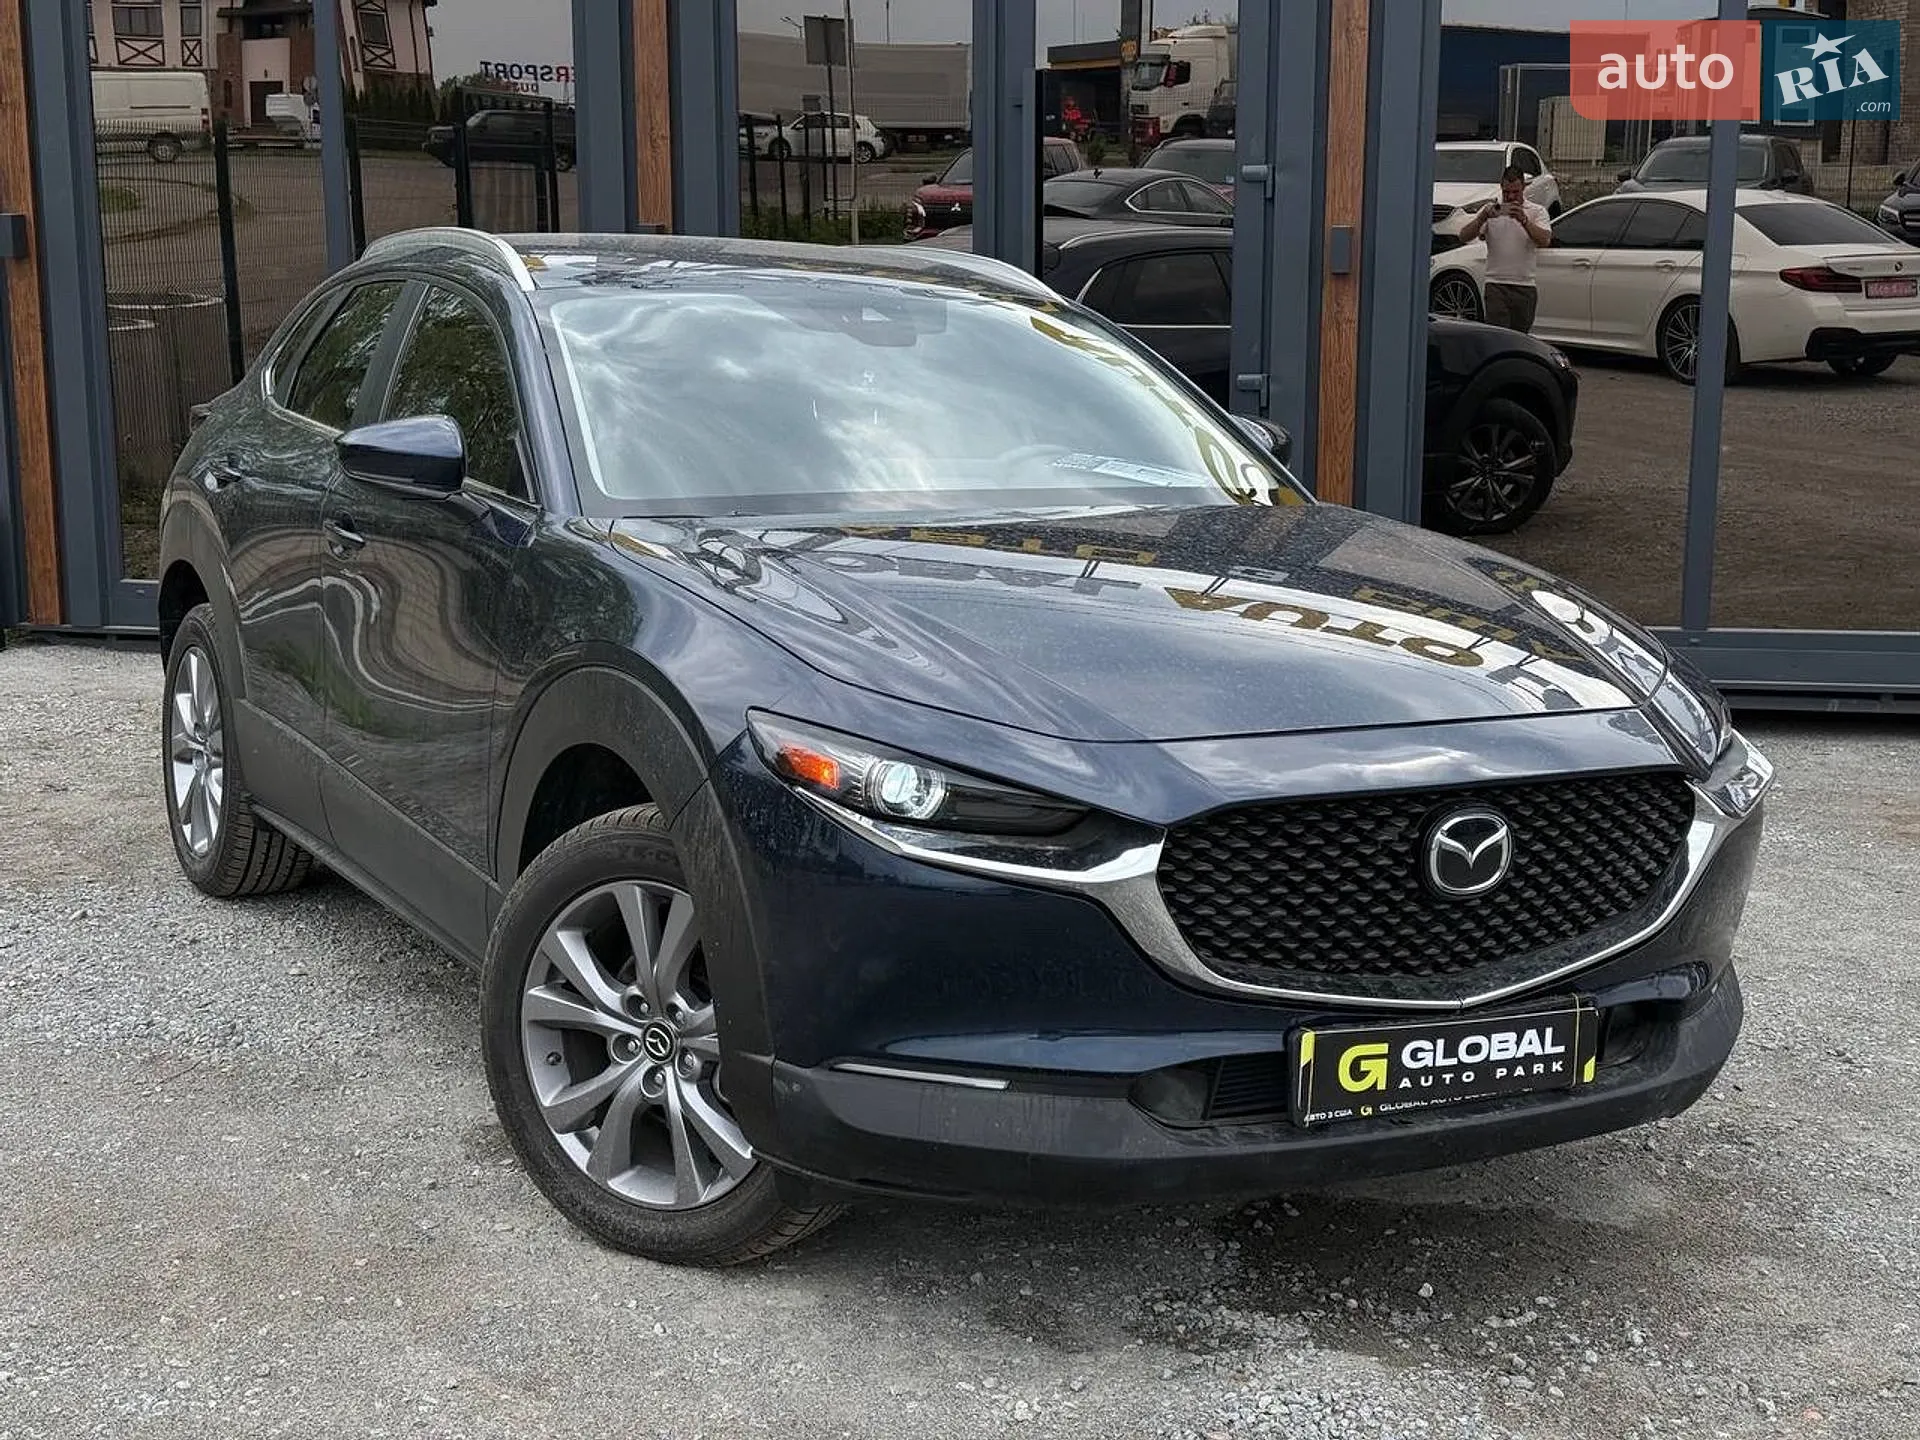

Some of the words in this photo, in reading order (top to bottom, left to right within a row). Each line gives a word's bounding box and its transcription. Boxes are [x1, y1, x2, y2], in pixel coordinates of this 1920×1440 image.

[1338, 1042, 1389, 1093] G
[1401, 1027, 1566, 1070] GLOBAL
[1398, 1071, 1476, 1089] AUTO
[1495, 1060, 1565, 1079] PARK
